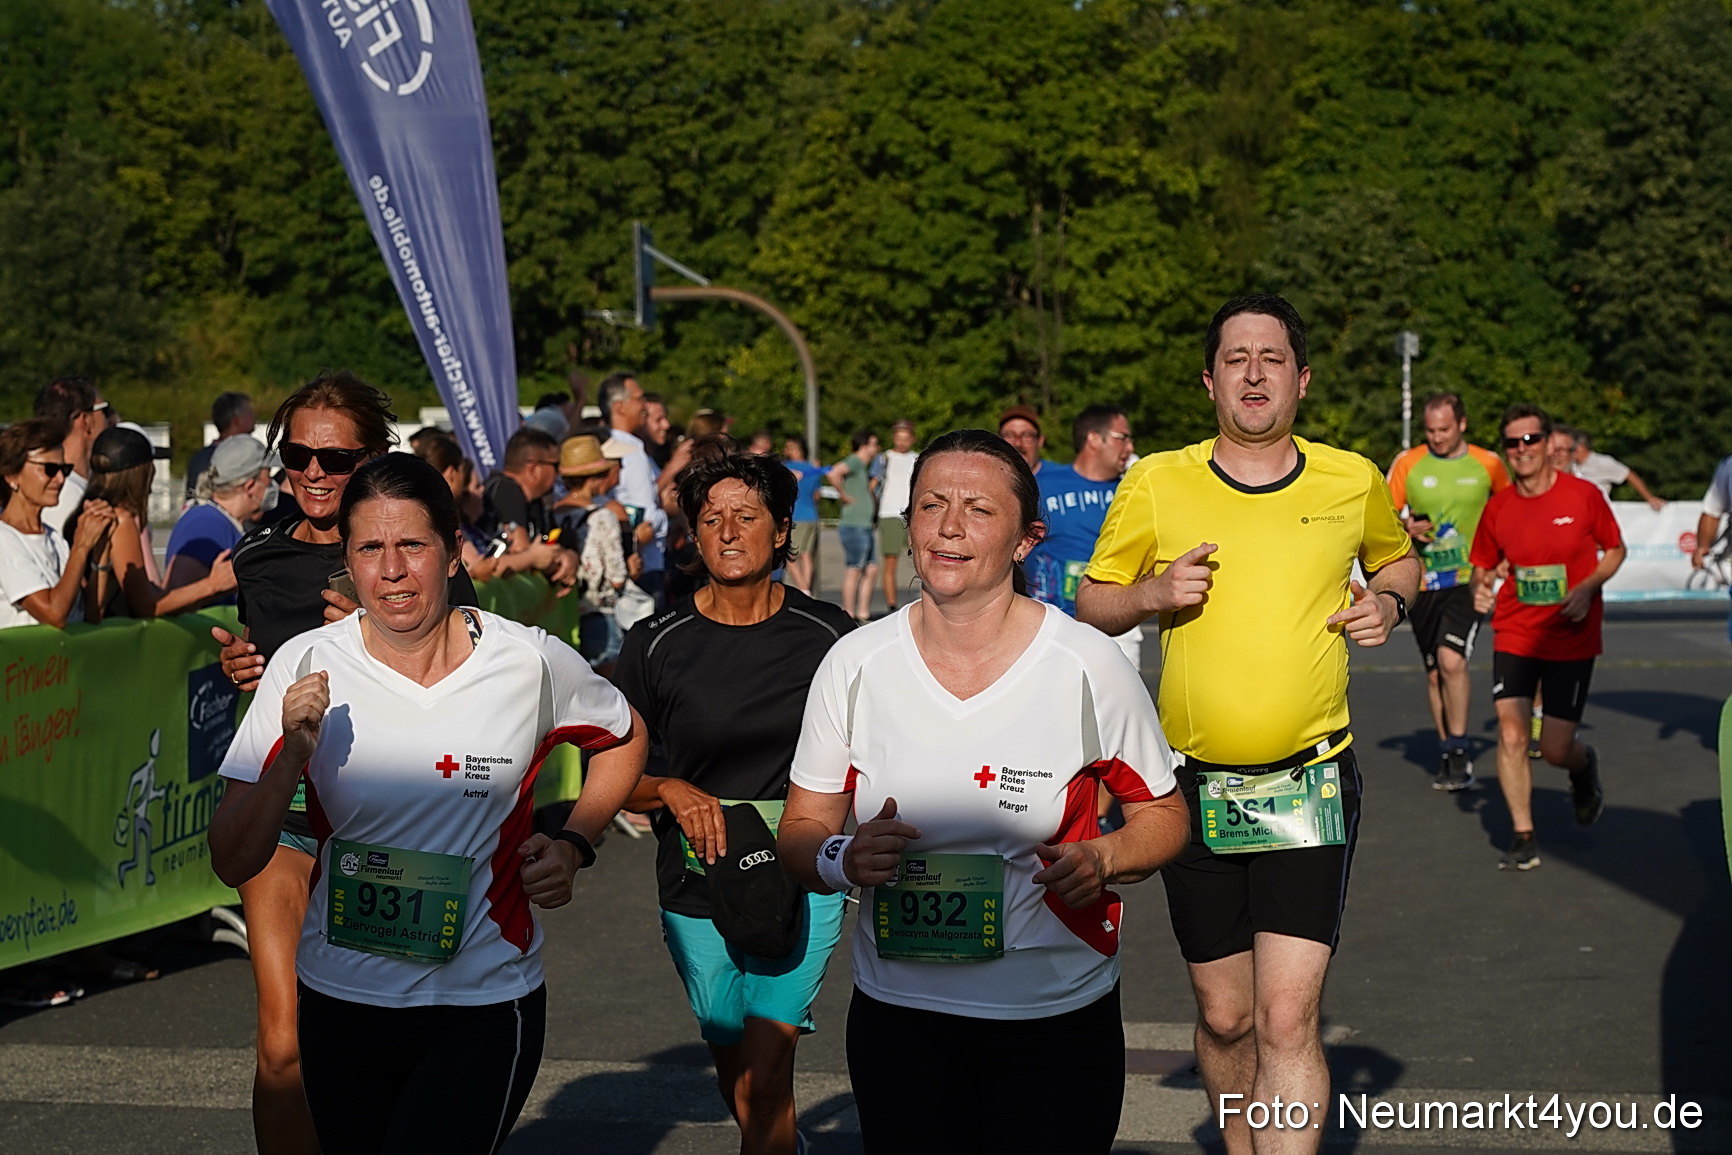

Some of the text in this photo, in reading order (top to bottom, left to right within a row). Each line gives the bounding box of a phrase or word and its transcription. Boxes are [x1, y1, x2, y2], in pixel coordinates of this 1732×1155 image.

[1311, 514, 1345, 523] SPANGLER
[658, 610, 677, 625] JAKO
[5, 655, 69, 702] Firmen
[15, 688, 81, 763] länger!
[465, 755, 513, 764] Bayerisches
[465, 763, 491, 772] Rotes
[1002, 766, 1053, 778] Bayerisches
[464, 772, 491, 780] Kreuz
[1001, 775, 1026, 785] Rotes
[463, 789, 489, 798] Astrid
[1000, 783, 1025, 793] Kreuz
[998, 800, 1029, 813] Margot
[1226, 797, 1276, 826] 561
[1207, 809, 1218, 838] RUN
[1293, 798, 1304, 835] 022
[1219, 829, 1249, 839] Brems
[360, 865, 404, 876] Firmenlauf
[901, 873, 942, 882] Firmenlauf
[334, 889, 345, 926] RUN
[357, 882, 424, 925] 931
[900, 891, 968, 927] 932
[440, 900, 459, 949] 2022
[880, 902, 889, 938] RUN
[983, 899, 996, 948] 2022
[342, 917, 441, 943] Ziervogel Astrid
[889, 928, 982, 940] Swaczyna Malgorzata
